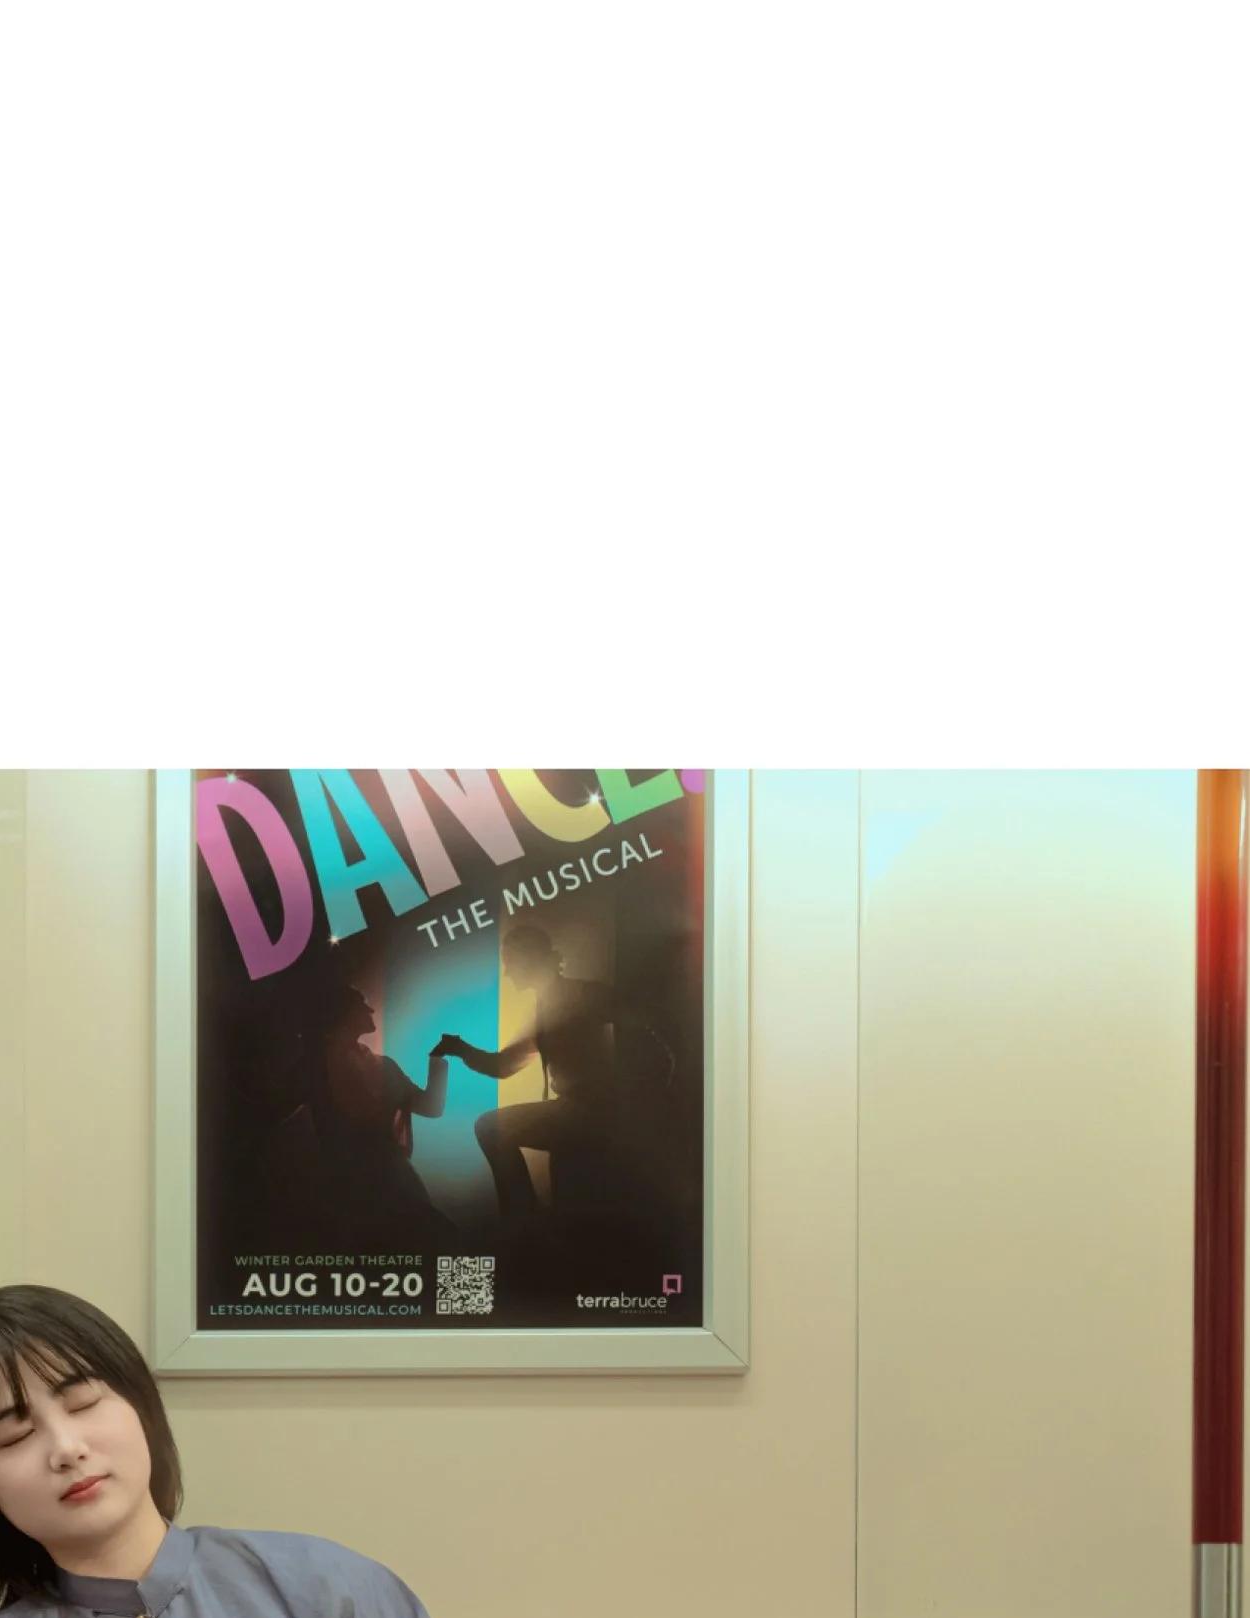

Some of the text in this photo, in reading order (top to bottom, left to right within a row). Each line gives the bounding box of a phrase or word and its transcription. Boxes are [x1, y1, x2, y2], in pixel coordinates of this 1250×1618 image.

[197, 769, 703, 981] DAN
[416, 833, 663, 948] THE MUSICAL
[235, 1255, 423, 1266] WINTER GARDEN THEATRE
[242, 1273, 423, 1297] AUG 10-20
[576, 1291, 667, 1308] terrabruce
[210, 1304, 421, 1316] LETSDANCETHEMUSICAL.COM
